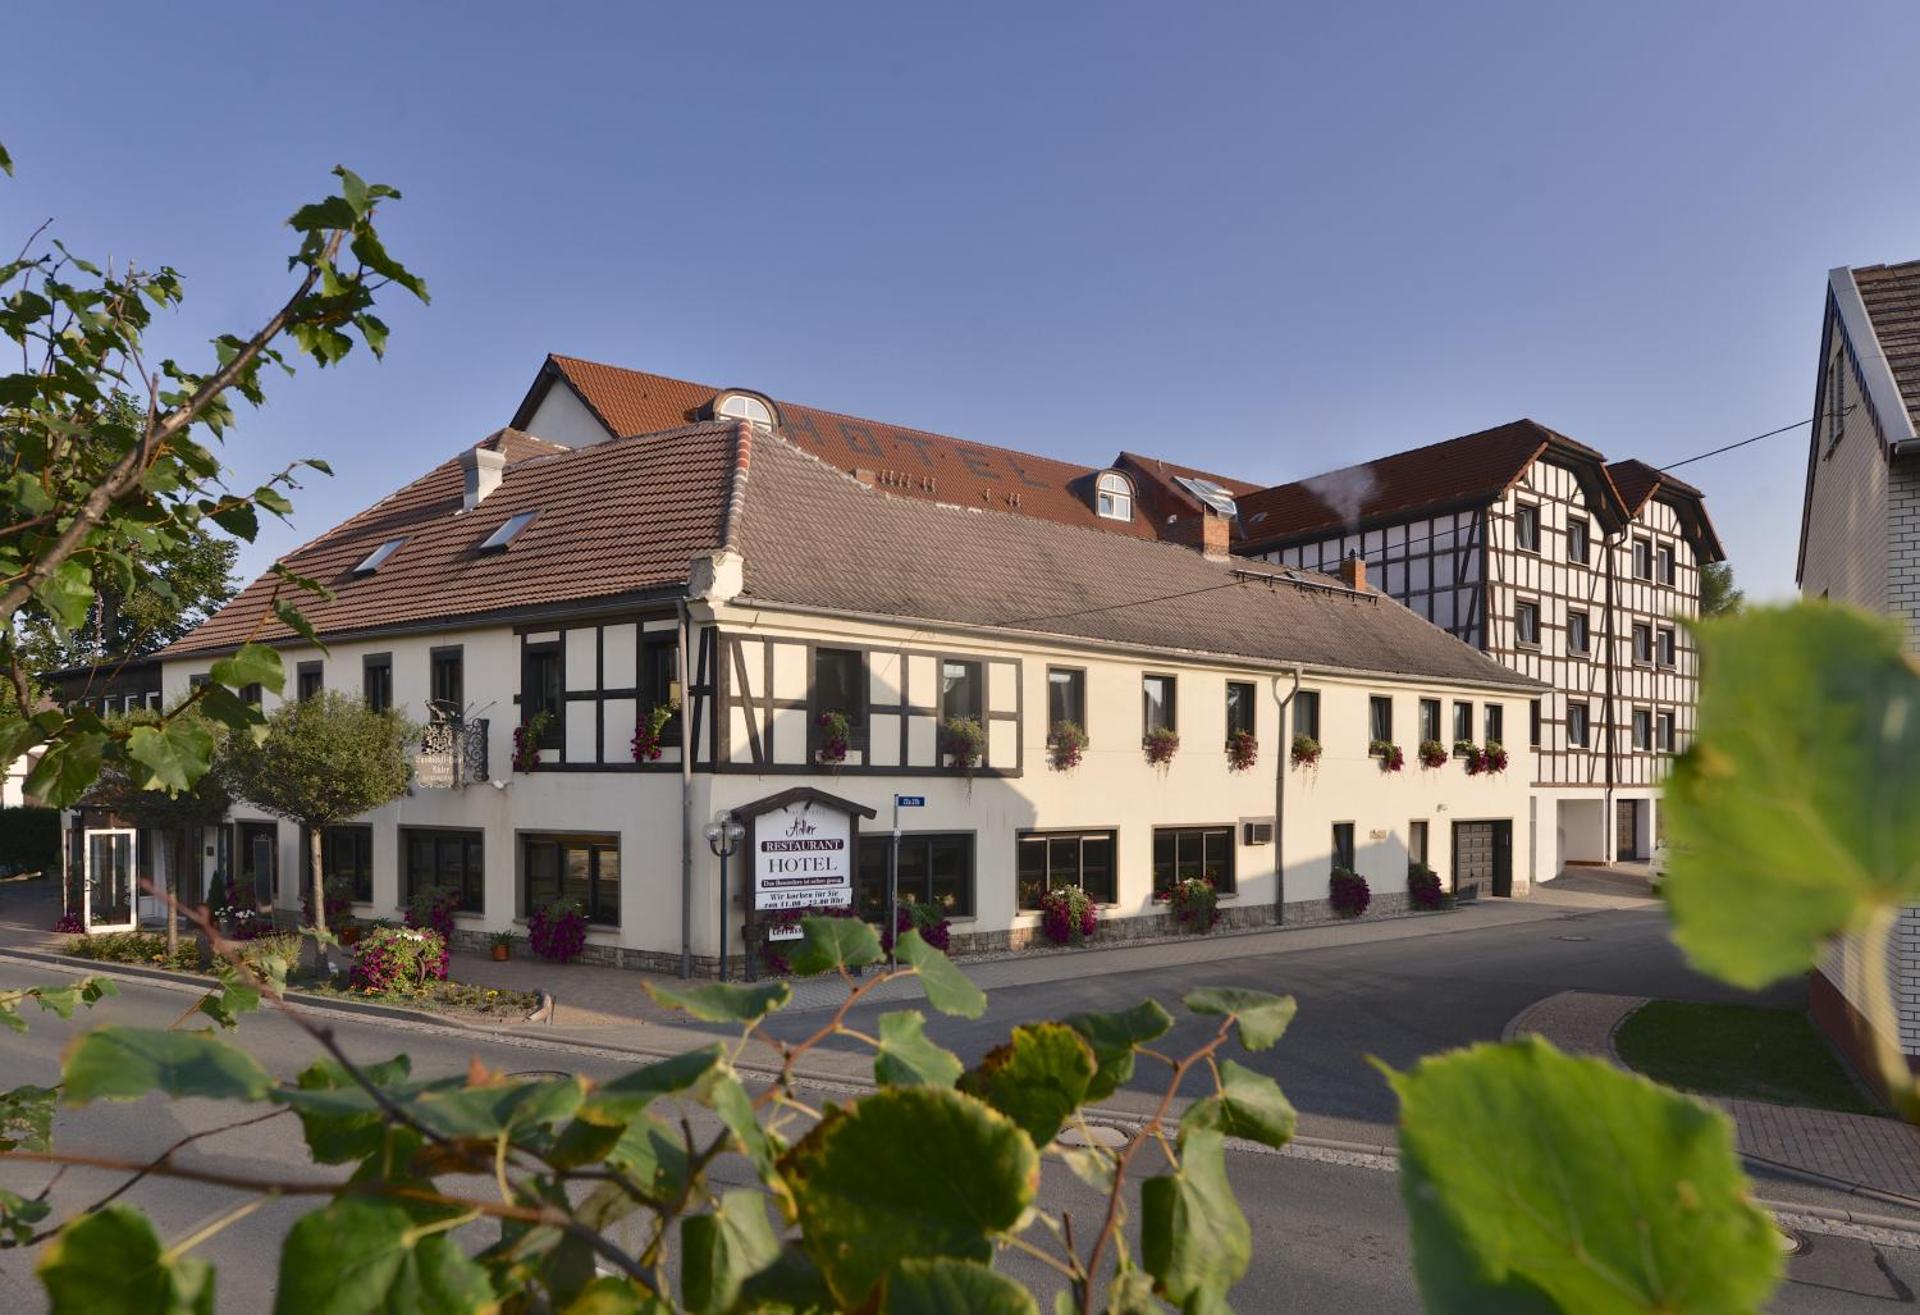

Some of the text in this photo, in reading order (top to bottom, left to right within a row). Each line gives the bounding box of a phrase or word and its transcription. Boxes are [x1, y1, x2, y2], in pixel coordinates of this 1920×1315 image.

[778, 408, 1052, 488] HOTEL
[785, 816, 818, 837] Adler
[766, 840, 841, 852] RESTAURANT
[768, 856, 838, 873] HOTEL
[770, 893, 783, 901] Wir
